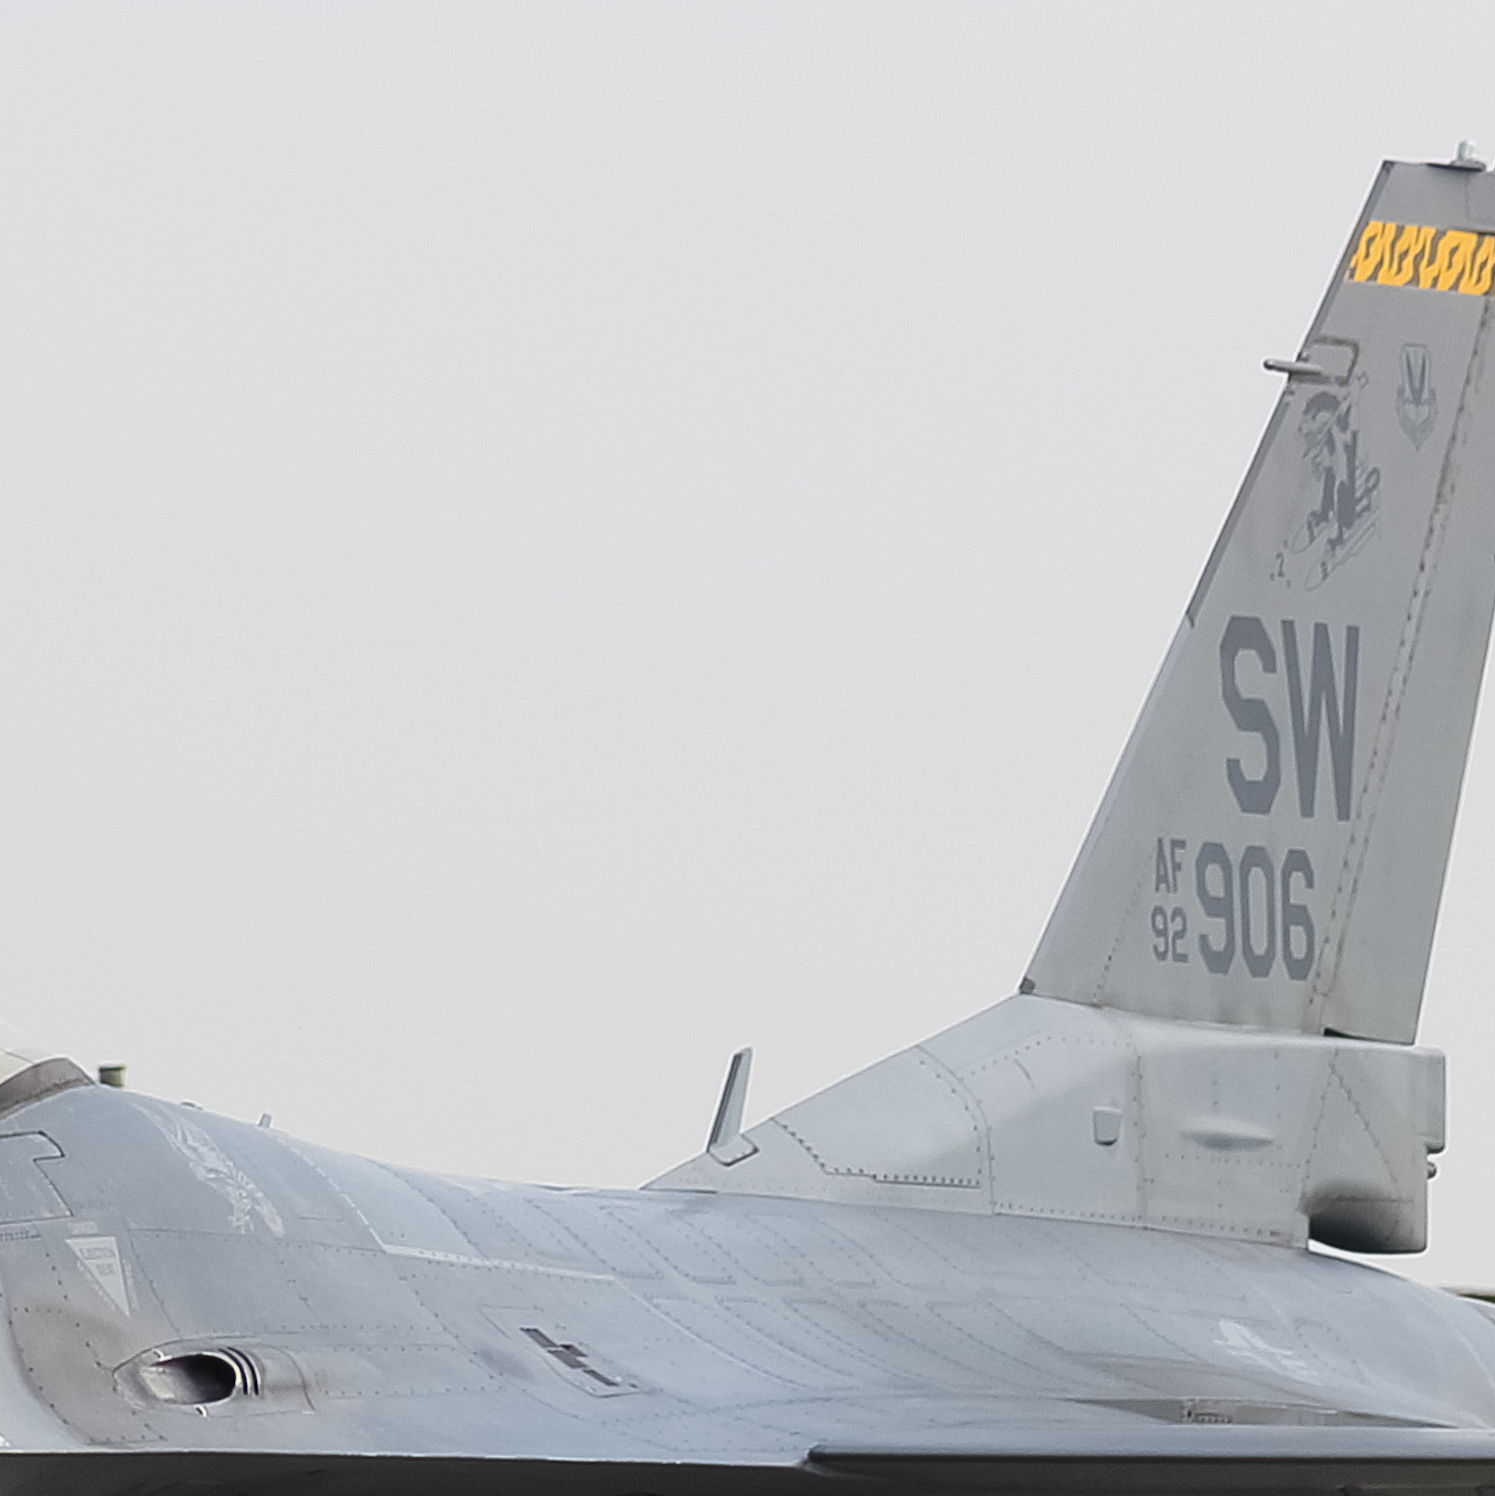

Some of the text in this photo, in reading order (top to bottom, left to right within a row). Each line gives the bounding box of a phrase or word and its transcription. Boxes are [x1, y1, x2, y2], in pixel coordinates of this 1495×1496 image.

[1219, 614, 1360, 821] SW
[1155, 837, 1186, 893] AF
[1195, 841, 1315, 981] 906
[1151, 904, 1189, 963] 92
